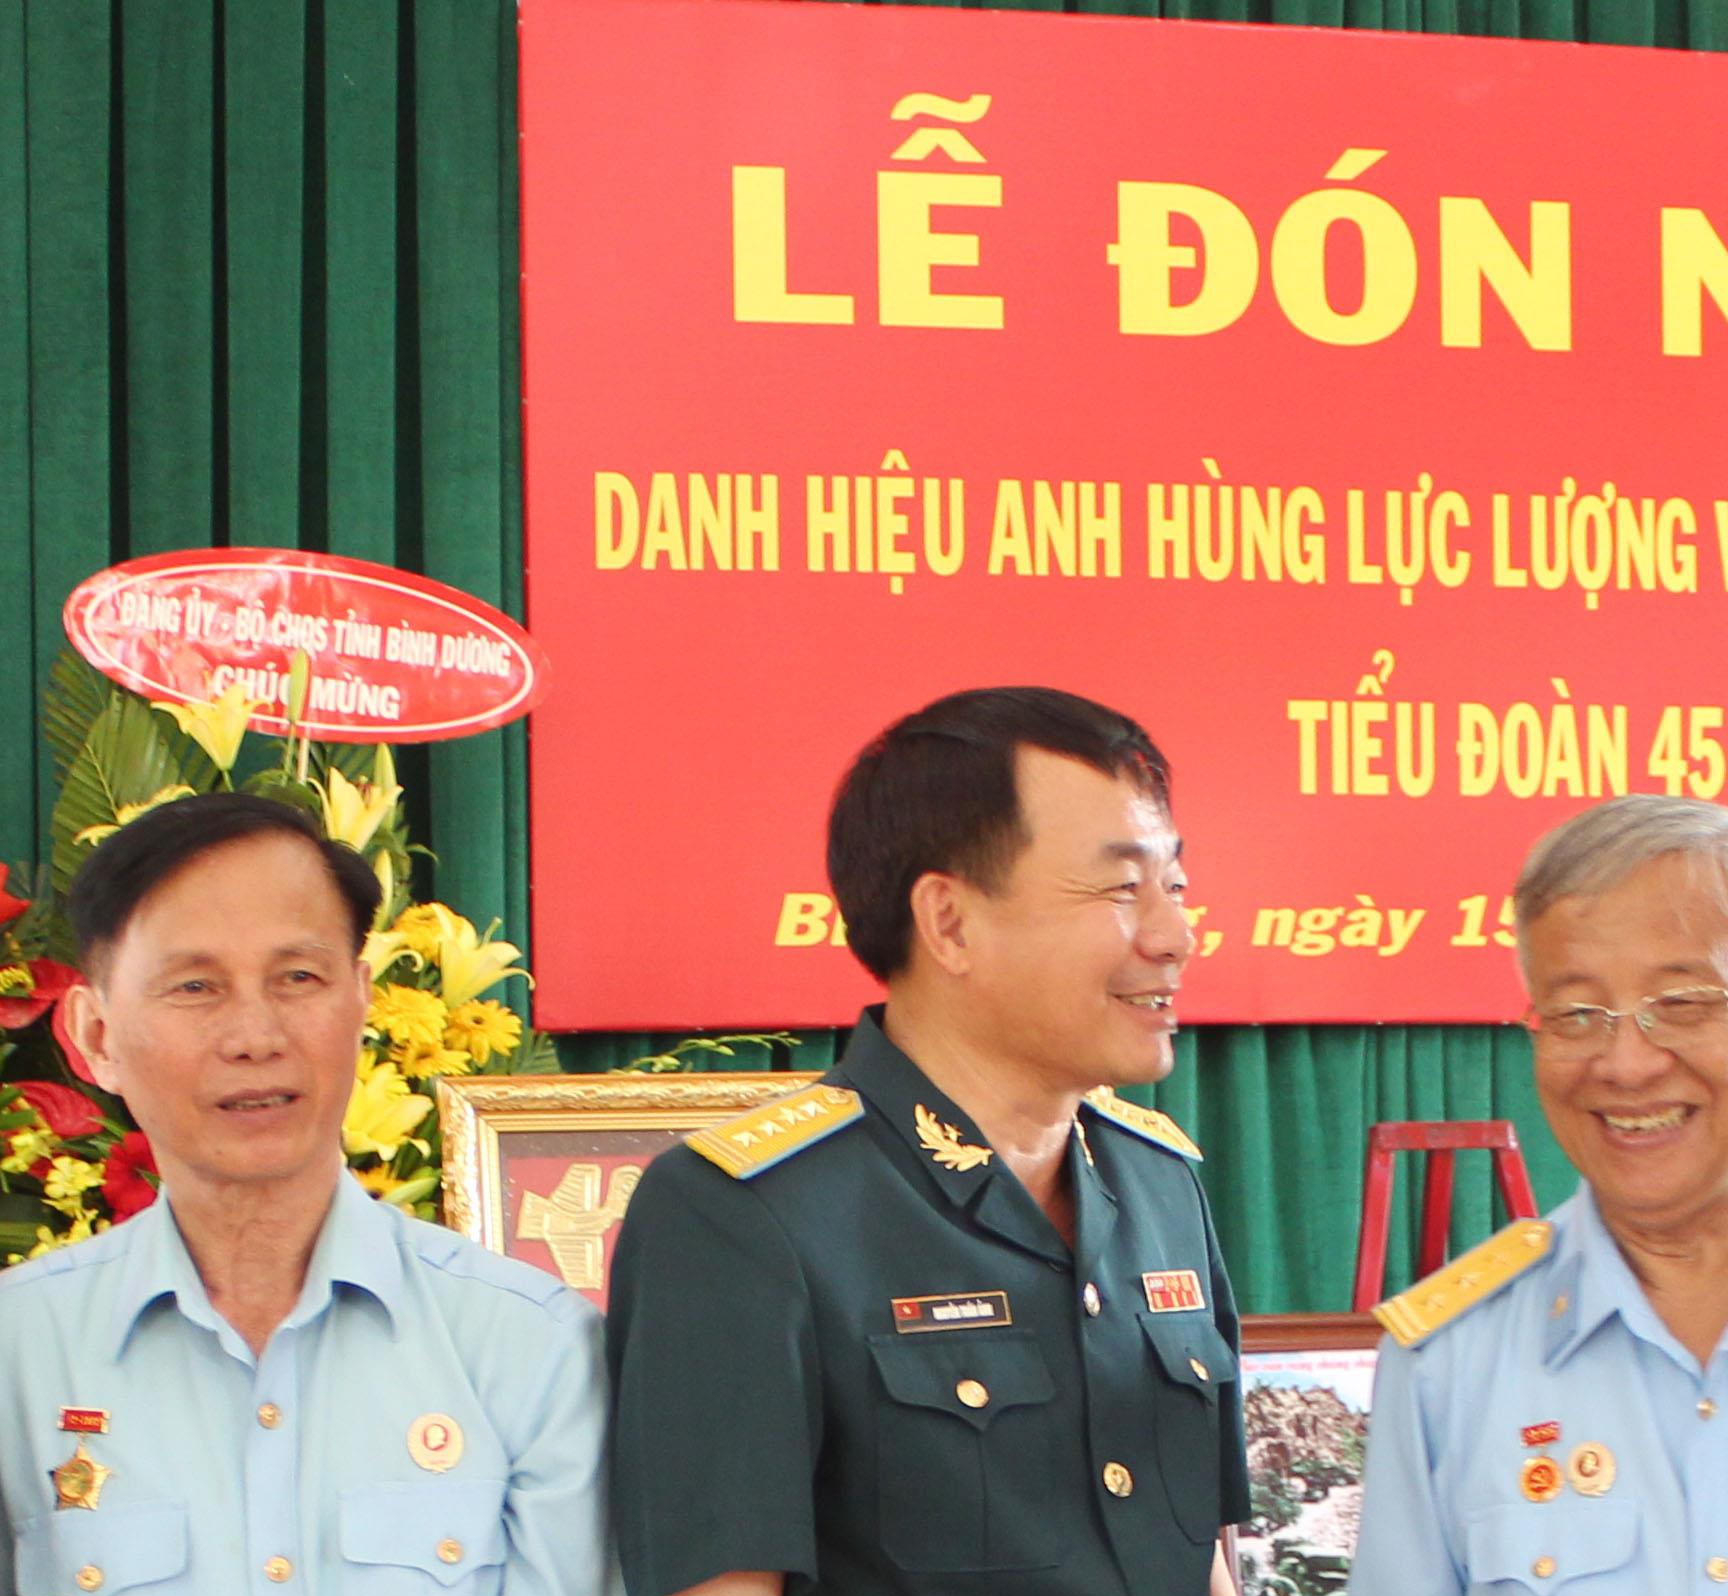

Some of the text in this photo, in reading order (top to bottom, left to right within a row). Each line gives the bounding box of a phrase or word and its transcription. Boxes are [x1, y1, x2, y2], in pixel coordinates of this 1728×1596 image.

[732, 93, 1004, 329] LỄ
[1107, 148, 1572, 352] ĐÓN
[595, 471, 780, 572] DANH
[806, 448, 965, 595] HIỆU
[988, 478, 1122, 578] ANH
[1147, 457, 1326, 585] HÙNG
[1347, 472, 1471, 606] LỰC
[1492, 476, 1698, 611] LƯỢNG
[235, 598, 265, 651] BỘ
[333, 608, 382, 660] TỈNH
[385, 619, 437, 668] BÌNH
[440, 631, 511, 678] DƯƠNG
[309, 671, 401, 720] MỪNG
[1287, 649, 1727, 799] TIỂU ĐOÀN 45
[1251, 894, 1426, 956] ngày
